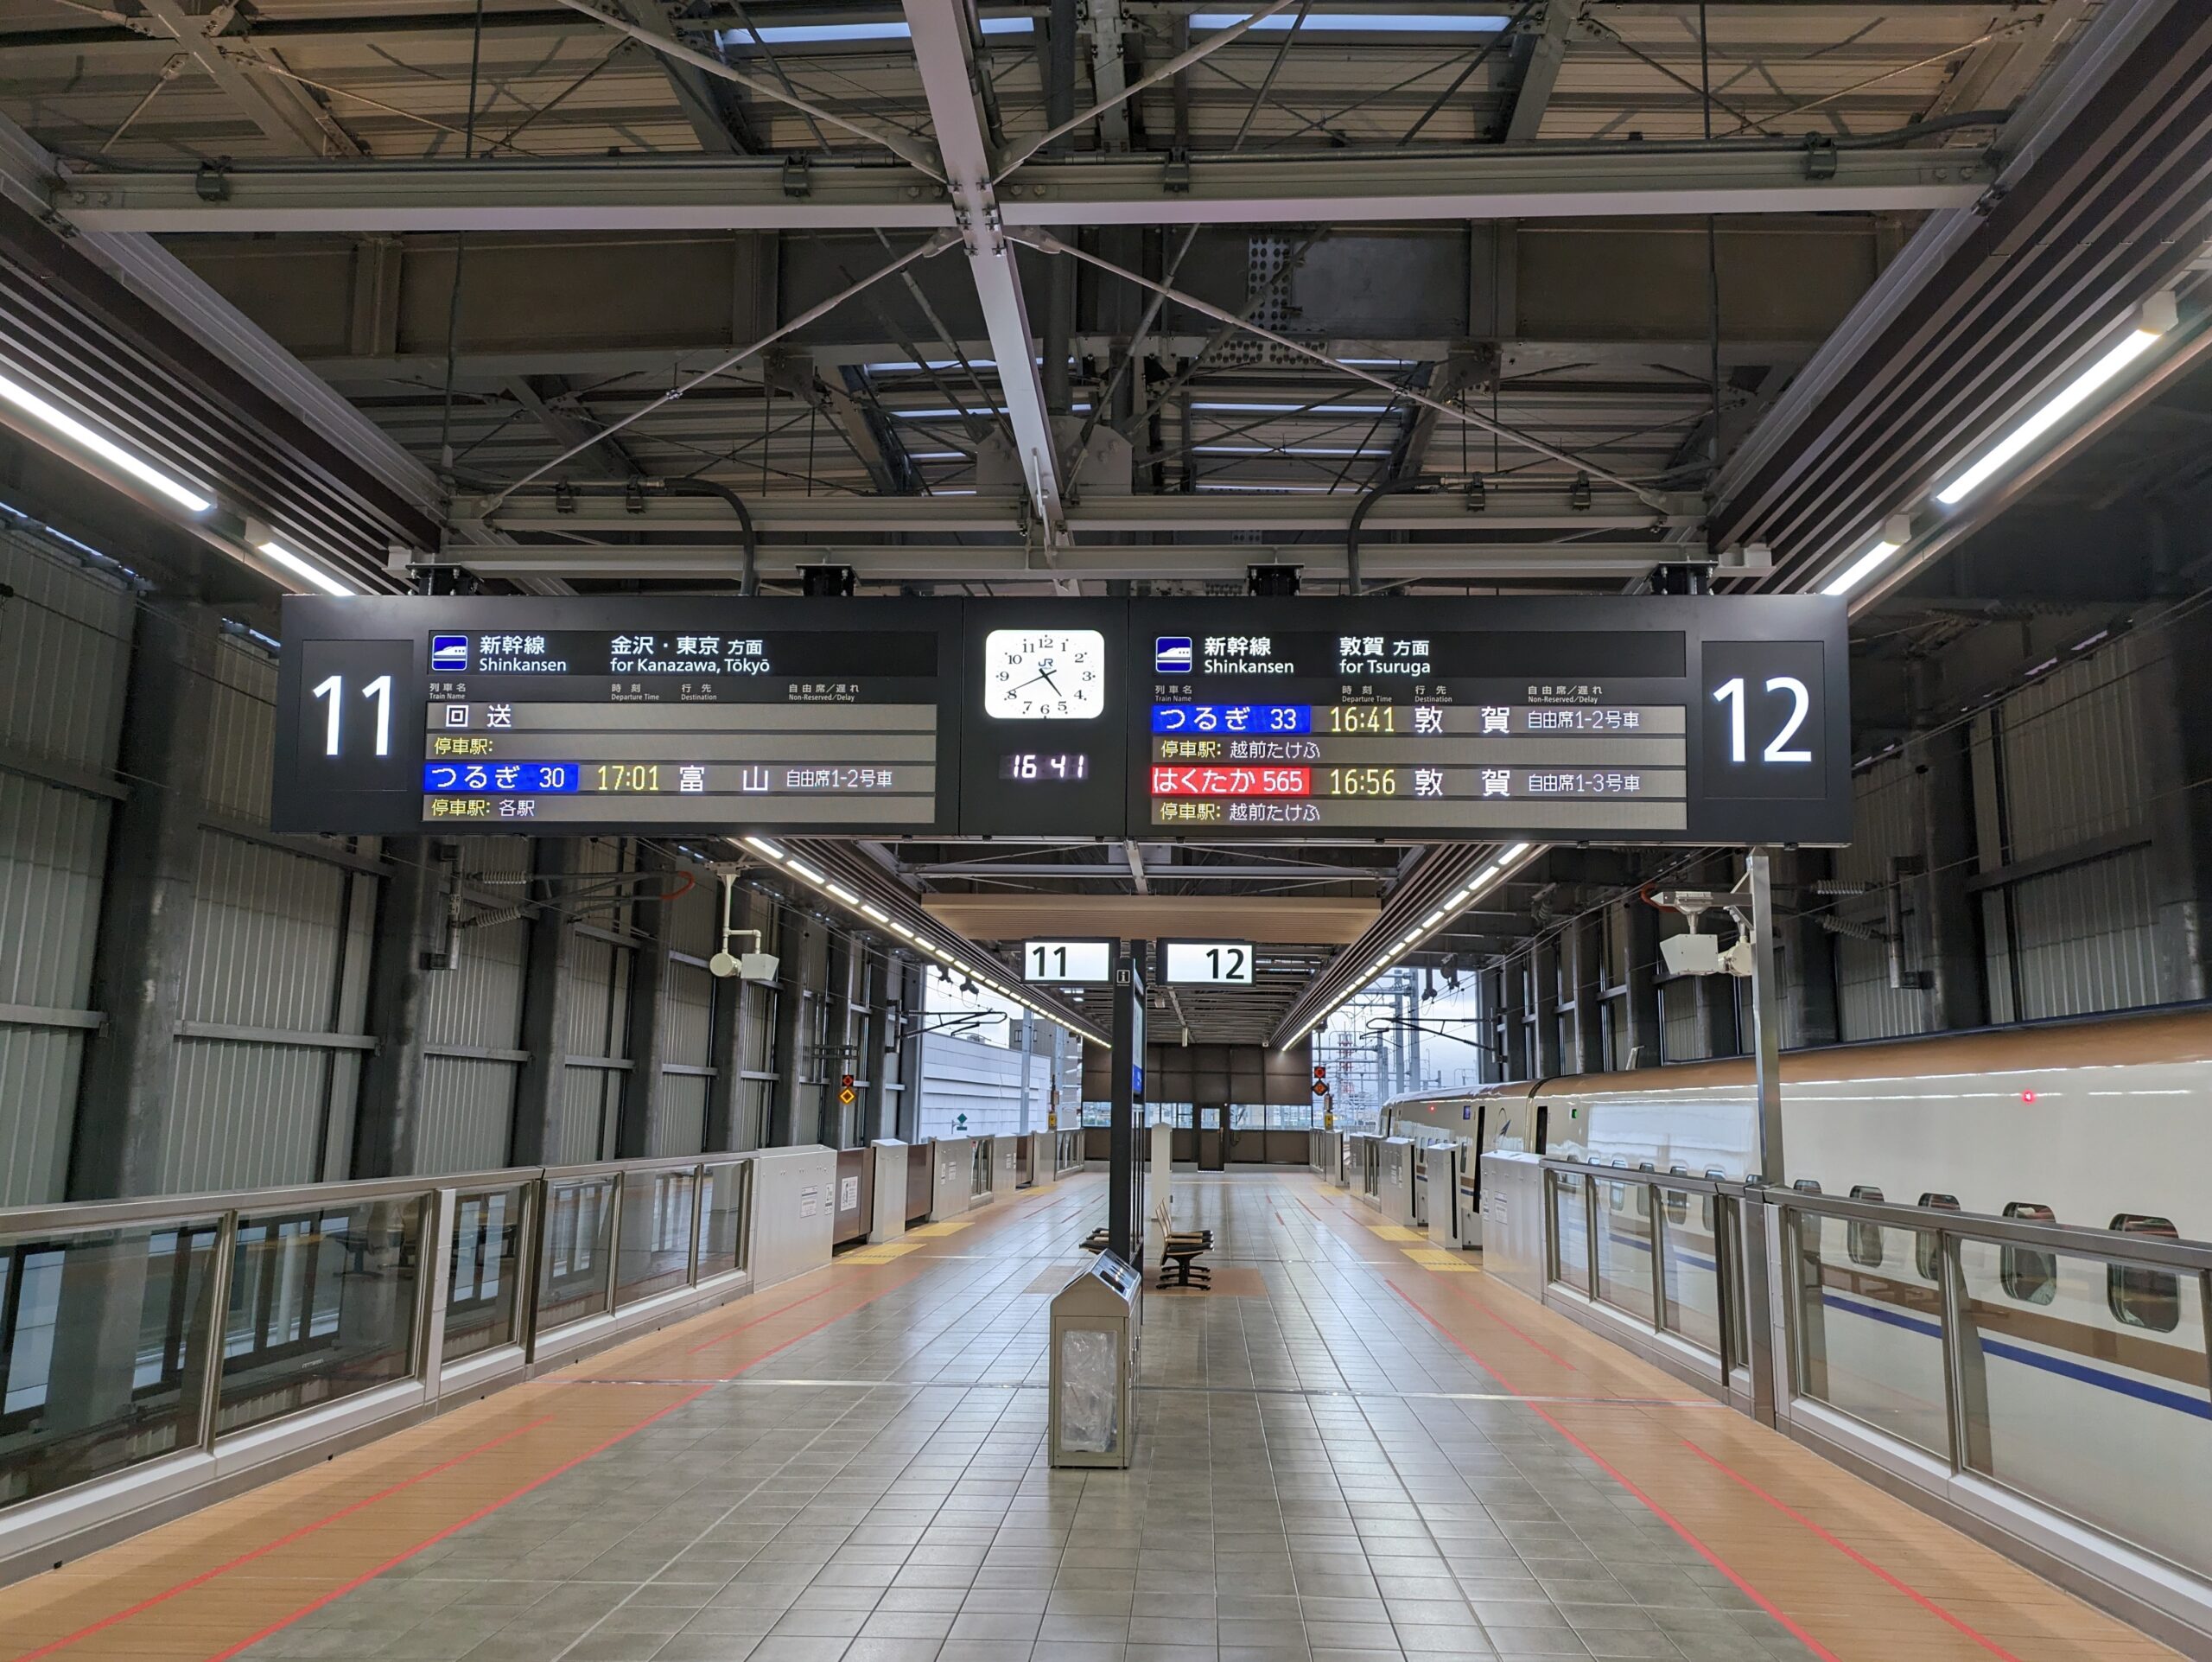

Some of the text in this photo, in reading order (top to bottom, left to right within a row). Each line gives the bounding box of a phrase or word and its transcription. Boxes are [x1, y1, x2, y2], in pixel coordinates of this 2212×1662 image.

[480, 635, 545, 655] 新幹線
[611, 635, 763, 656] 金沢・東京 方面
[1022, 643, 1035, 653] 11
[1038, 638, 1053, 648] 12
[1061, 642, 1067, 652] 1
[1205, 636, 1272, 657] 新幹線
[1339, 636, 1430, 657] 敦賀 方面
[479, 657, 567, 672] Shinkansen
[1007, 654, 1022, 665] 10
[1038, 658, 1053, 666] JR
[1074, 653, 1084, 663] 2
[610, 658, 770, 676] for Kanazawa, Tōkyō
[1205, 659, 1294, 675] Shinkansen
[1339, 659, 1431, 678] for Tsuruga
[999, 672, 1009, 681] 9
[1082, 672, 1092, 681] 3
[429, 683, 467, 692] 列車名
[1007, 690, 1017, 700] 8
[1074, 690, 1084, 699] 4
[1154, 685, 1192, 695] 列車名
[611, 693, 643, 703] Departure
[1023, 701, 1033, 711] 7
[1058, 701, 1067, 711] 5
[1342, 695, 1376, 704] Departure
[312, 675, 393, 756] 11
[445, 704, 512, 728] 回送
[1040, 704, 1050, 715] 6
[1160, 707, 1250, 731] つるぎ
[1270, 708, 1297, 729] 33
[1330, 706, 1395, 732] 16:41
[1528, 710, 1639, 729] 自由席1-2号車
[1713, 677, 1812, 762] 12
[434, 737, 493, 755] 停車駅:
[1160, 740, 1320, 759] 停車駅: 越前たけふ
[1013, 755, 1084, 778] 16 41
[431, 765, 520, 790] つるぎ
[539, 767, 565, 789] 30
[597, 766, 659, 791] 17:01
[785, 768, 893, 787] 自由席1-2号車
[1154, 768, 1255, 793] はくたか
[1263, 770, 1303, 792] 565
[1330, 769, 1395, 795] 16:56
[1528, 773, 1641, 793] 自由席1-3号車
[431, 799, 535, 817] 停車駅: 各駅
[1160, 802, 1320, 822] 停車駅: 越前たけふ
[1033, 946, 1066, 977] 11
[1206, 948, 1245, 979] 12
